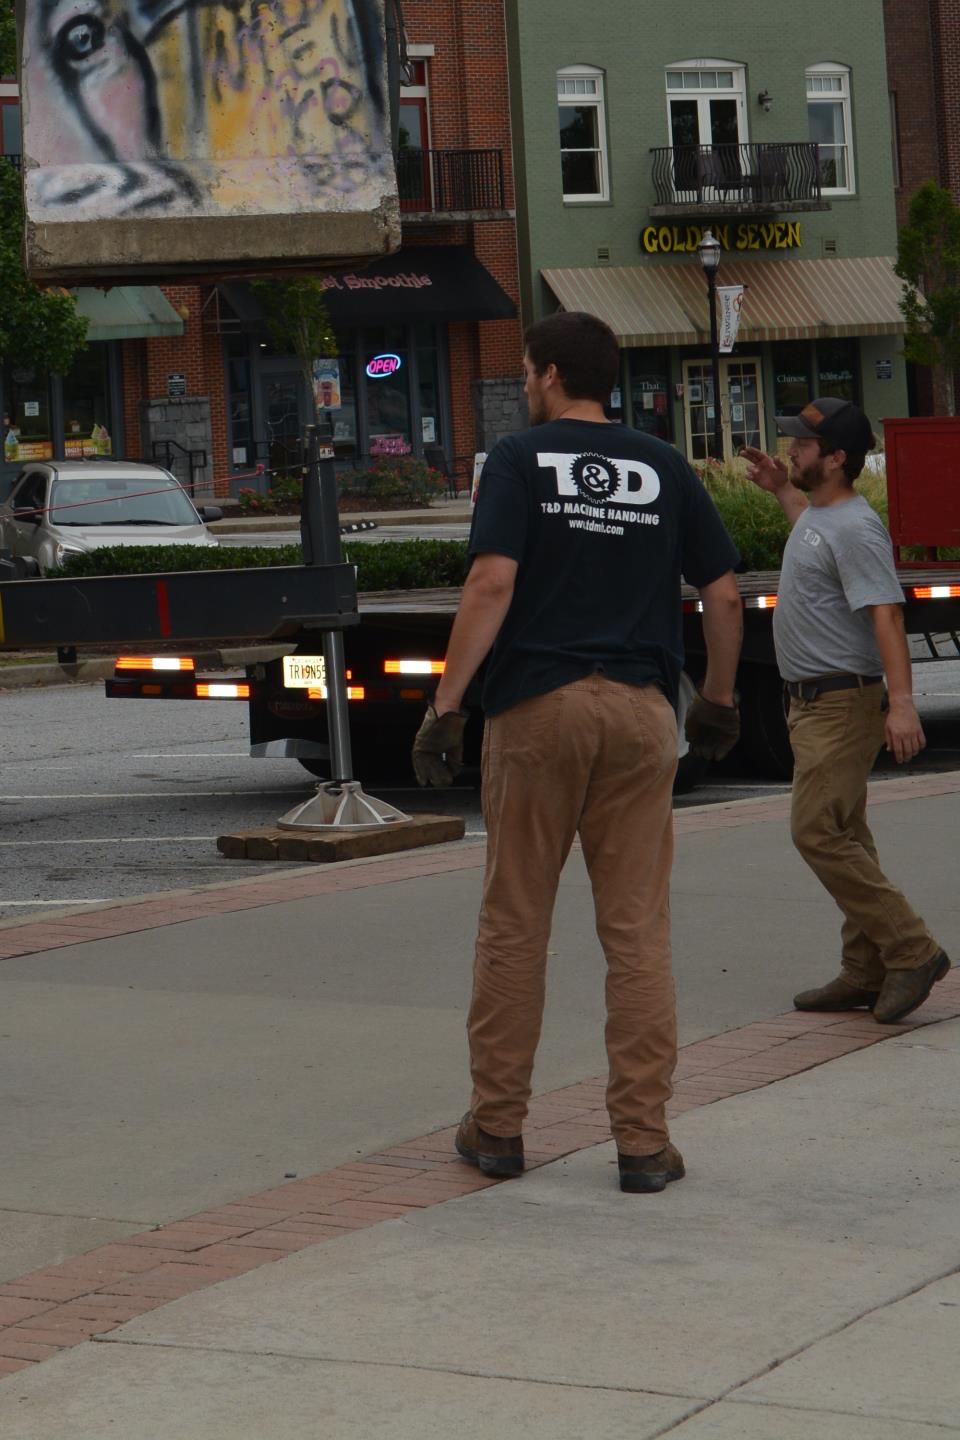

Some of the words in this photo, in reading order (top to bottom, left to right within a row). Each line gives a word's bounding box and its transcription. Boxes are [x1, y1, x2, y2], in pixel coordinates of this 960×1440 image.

[736, 220, 802, 250] SEVEN
[343, 272, 433, 291] Smoothie
[369, 359, 397, 374] OPEN
[776, 374, 807, 384] Chinese
[536, 452, 661, 505] T&D
[541, 502, 561, 514] T&D
[564, 503, 605, 519] MACHINE
[607, 509, 660, 526] HANDLING
